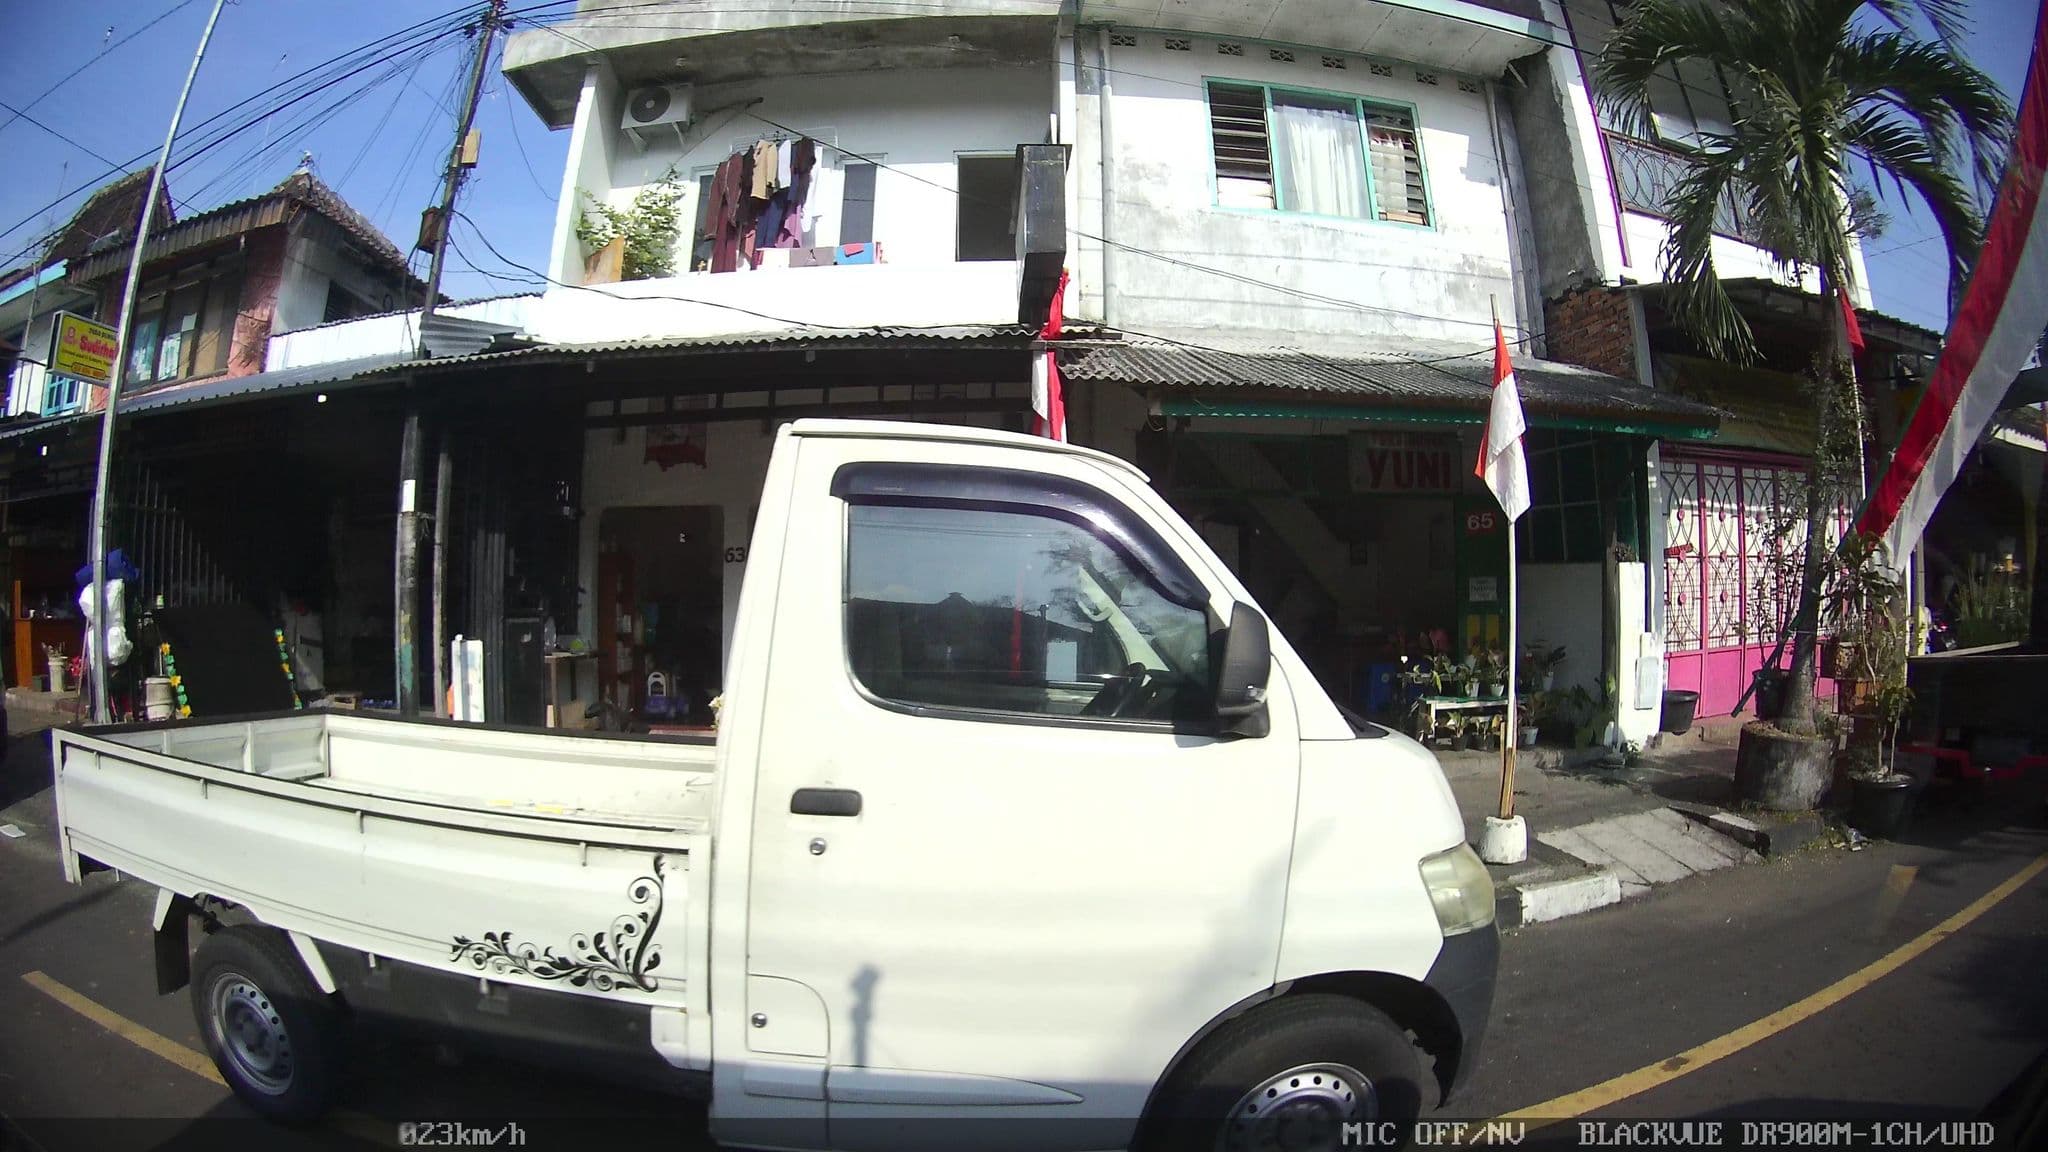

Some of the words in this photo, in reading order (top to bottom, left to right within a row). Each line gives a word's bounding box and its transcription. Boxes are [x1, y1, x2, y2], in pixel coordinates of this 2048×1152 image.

[1367, 448, 1450, 489] YUNI
[1467, 512, 1494, 530] 65
[725, 546, 745, 563] 63
